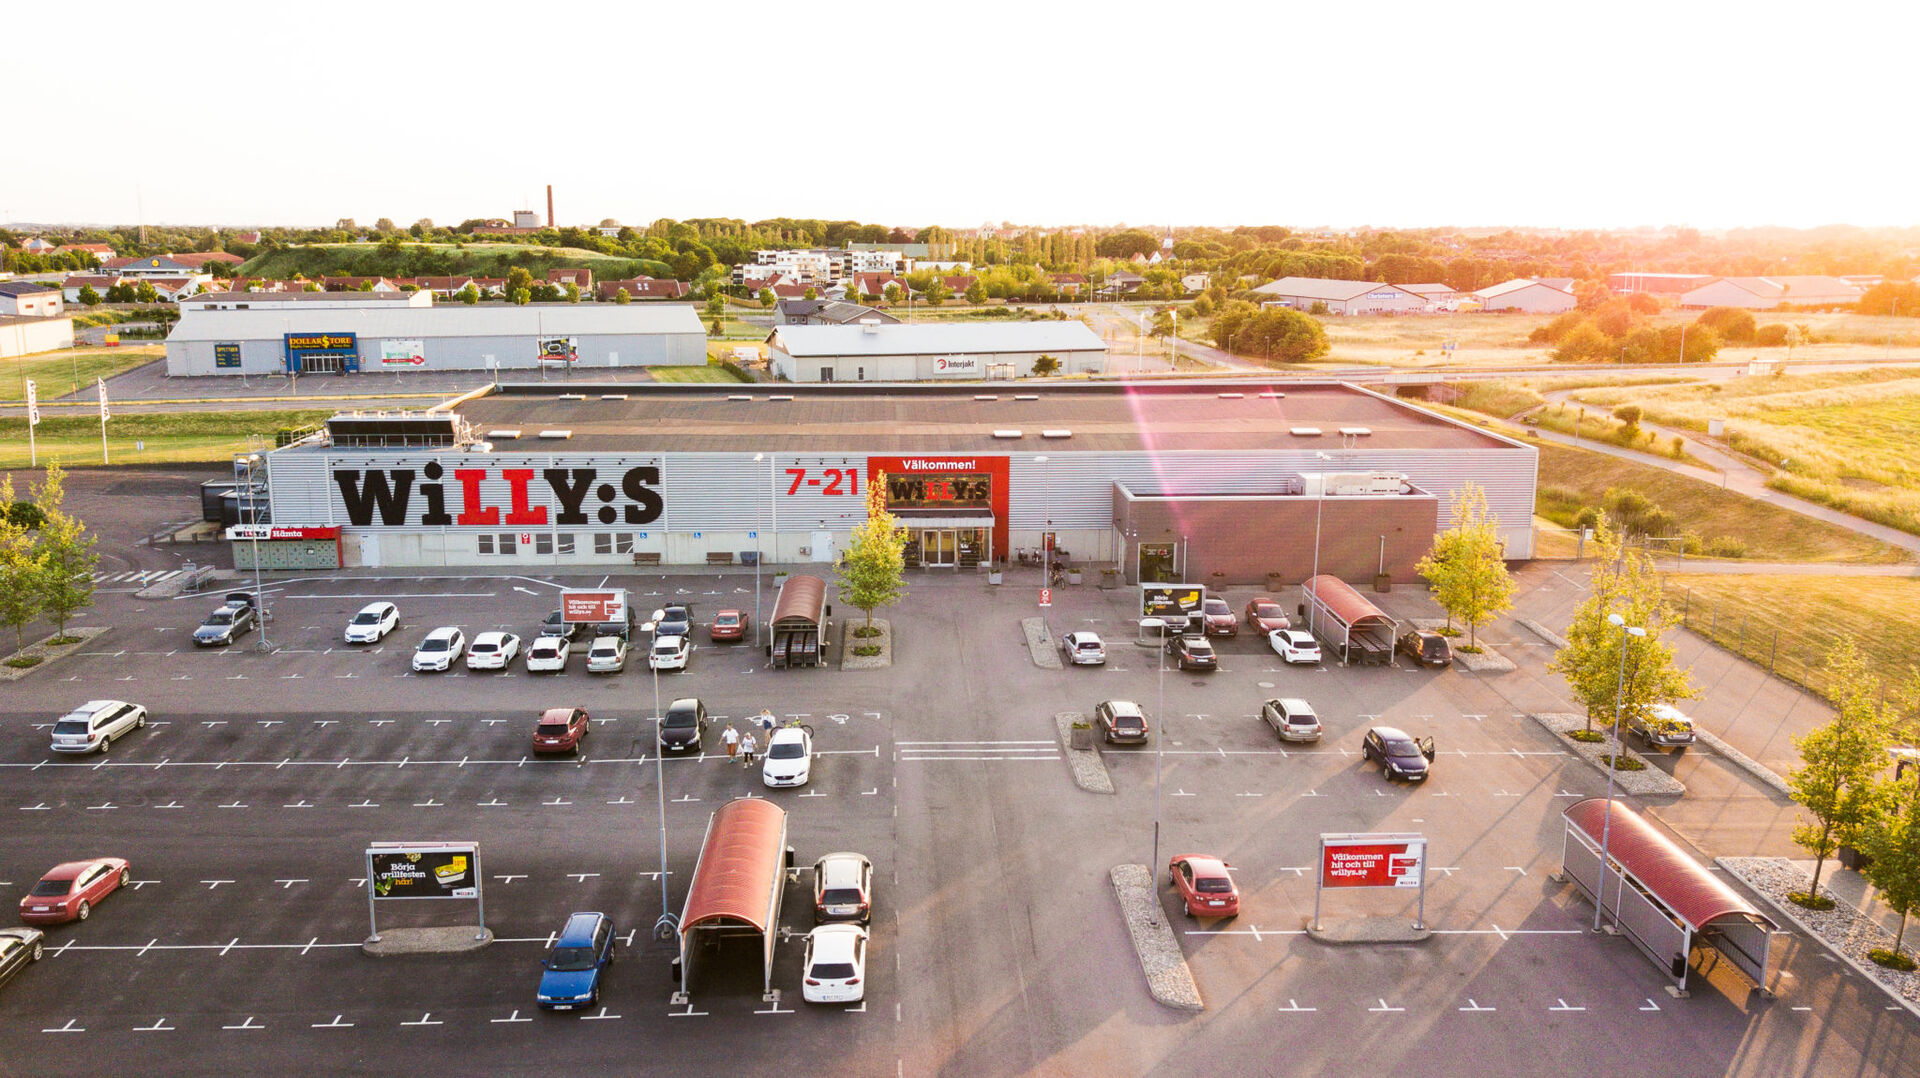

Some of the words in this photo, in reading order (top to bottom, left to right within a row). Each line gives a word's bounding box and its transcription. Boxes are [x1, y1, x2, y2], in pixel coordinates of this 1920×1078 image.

[948, 360, 975, 369] Interjakt
[902, 459, 976, 470] Välkommen!
[785, 468, 858, 495] 7-21
[1331, 853, 1384, 861] Välkommen
[390, 862, 416, 873] Börja
[381, 871, 426, 880] grillfesten
[1331, 868, 1368, 877] willys.se
[395, 878, 413, 886] här!
